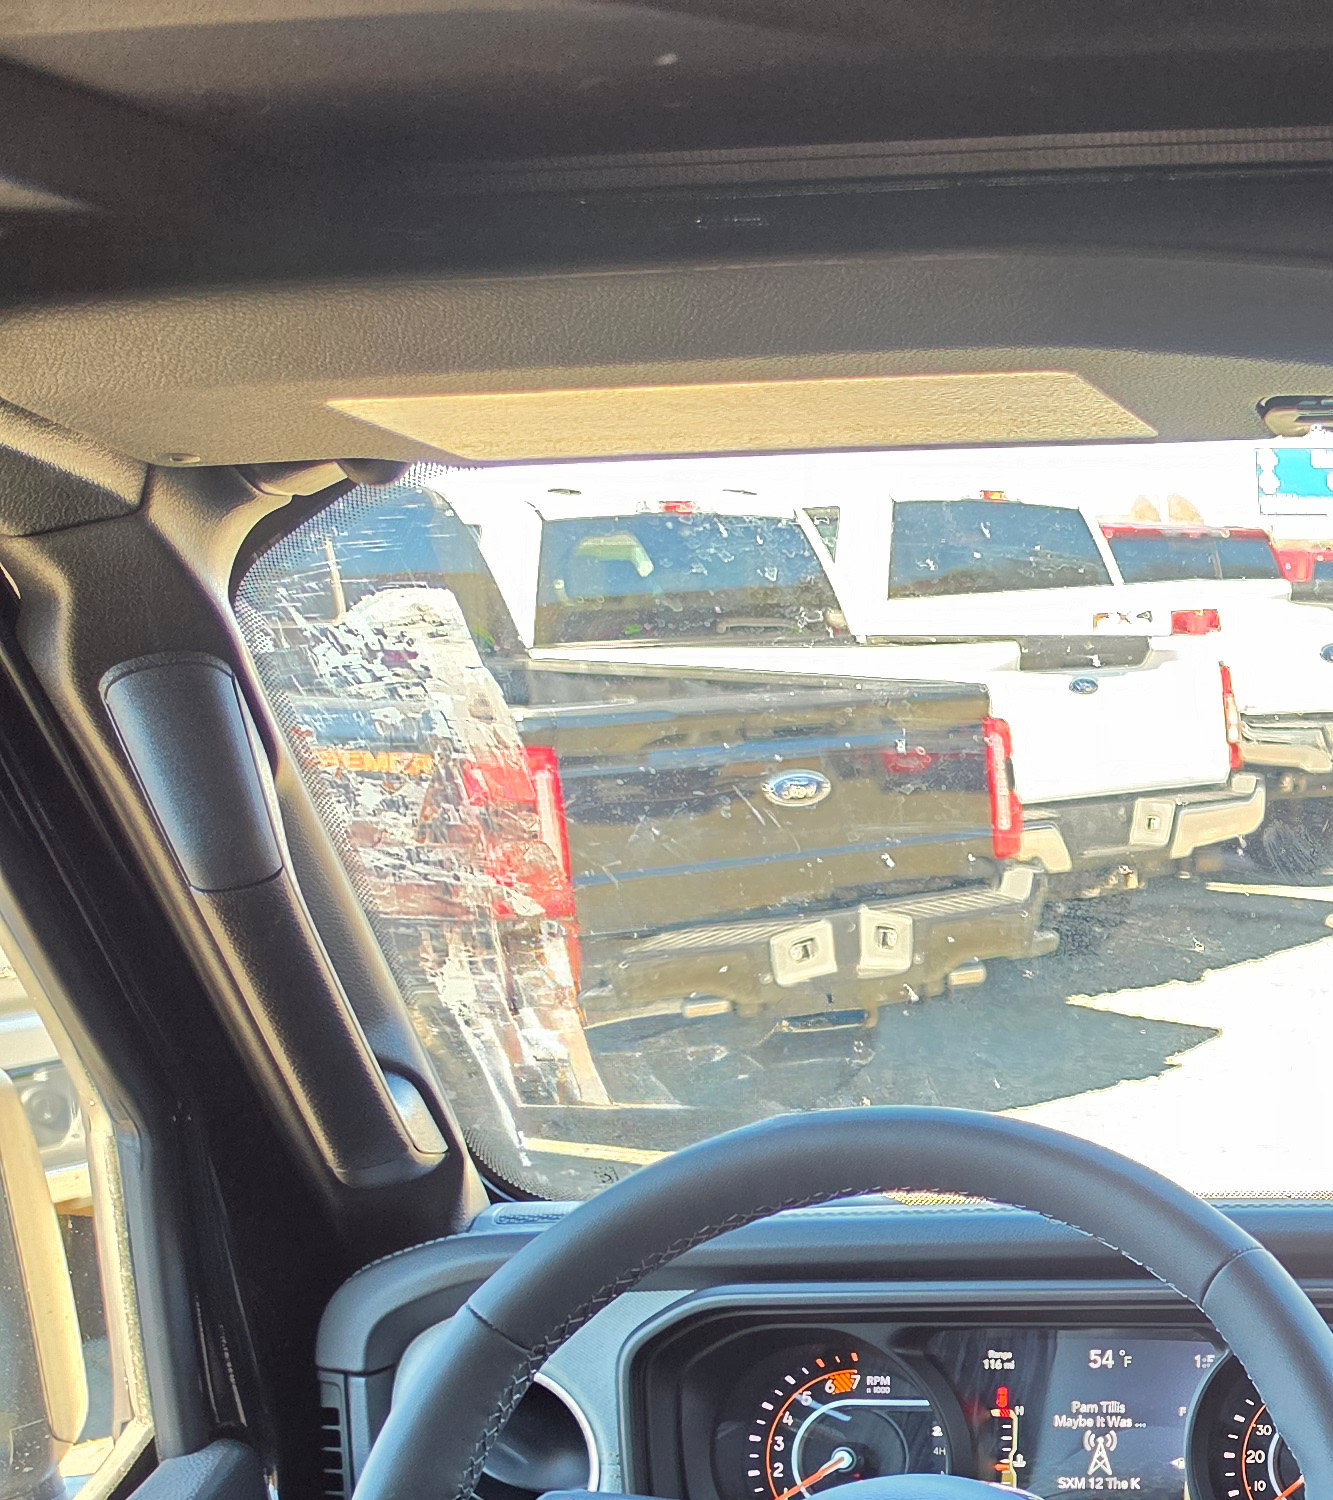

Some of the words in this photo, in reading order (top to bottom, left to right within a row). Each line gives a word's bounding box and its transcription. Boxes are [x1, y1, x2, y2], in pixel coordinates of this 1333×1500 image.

[982, 1359, 1002, 1370] 116
[1089, 1349, 1114, 1369] 54
[825, 1379, 835, 1394] 6
[850, 1375, 860, 1389] 7
[866, 1375, 891, 1386] RPM
[801, 1390, 812, 1406] 5
[1015, 1405, 1024, 1415] H
[1071, 1401, 1099, 1414] Pam
[1100, 1401, 1126, 1414] Tillis
[782, 1411, 793, 1426] 4
[1053, 1415, 1094, 1429] Maybe
[1096, 1415, 1105, 1427] It
[1106, 1415, 1132, 1427] Was
[1256, 1425, 1272, 1436] 30
[774, 1436, 785, 1451] 3
[933, 1446, 946, 1456] 4H
[1246, 1450, 1265, 1464] 20
[773, 1462, 784, 1478] 2
[1057, 1477, 1086, 1490] SXM
[1089, 1477, 1103, 1490] 12
[1105, 1477, 1128, 1490] The
[1130, 1477, 1141, 1490] K
[1254, 1480, 1266, 1491] 10
